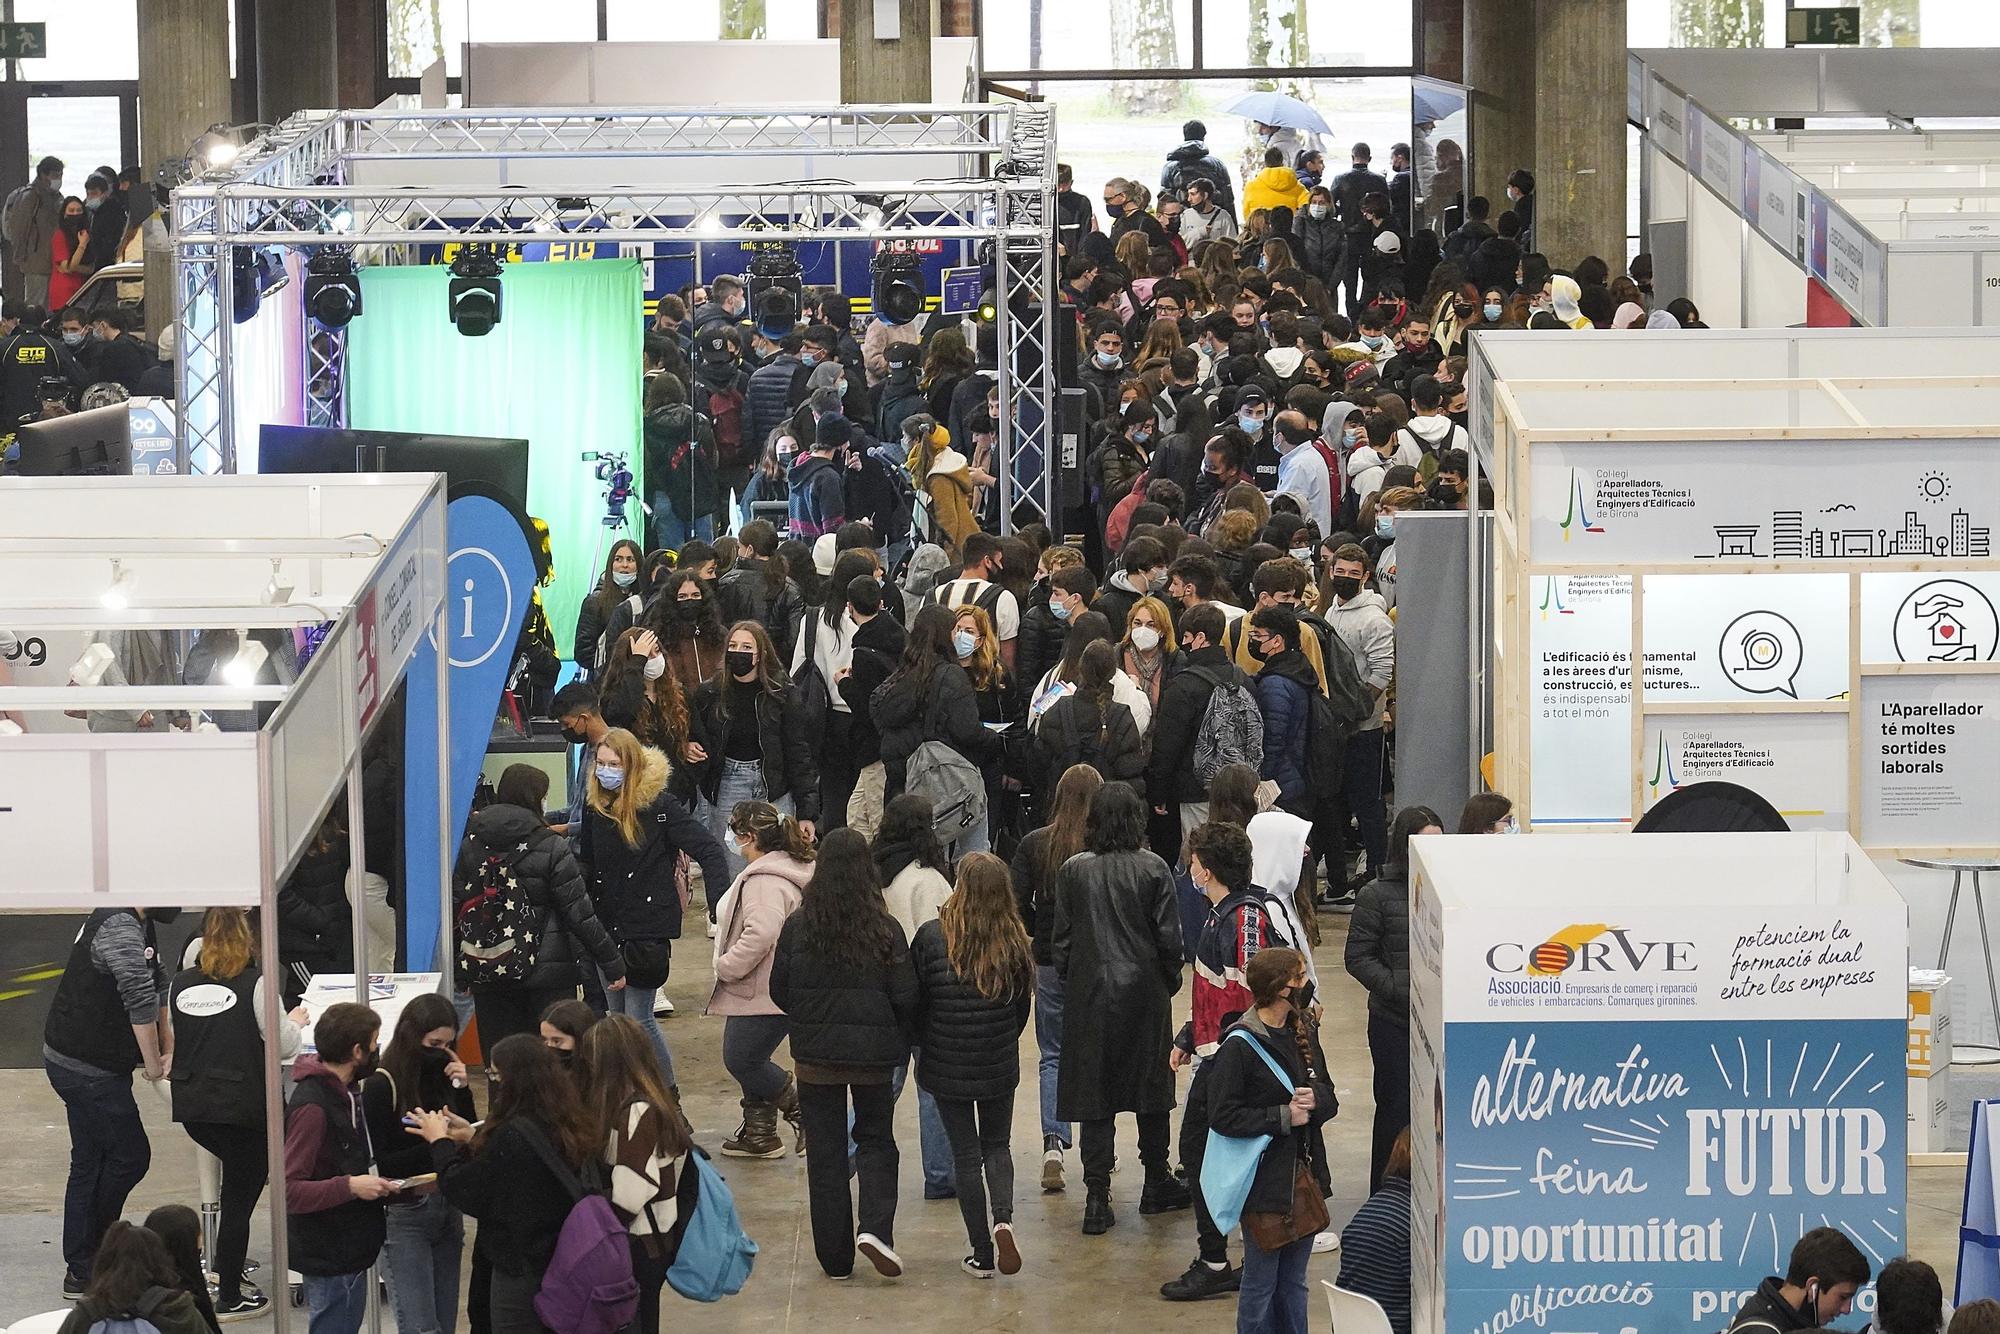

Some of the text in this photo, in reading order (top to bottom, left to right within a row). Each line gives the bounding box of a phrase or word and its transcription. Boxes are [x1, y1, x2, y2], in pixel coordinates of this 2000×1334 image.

[1596, 480, 1664, 489] d'Aparelladors,
[1596, 490, 1650, 499] Arquitectes
[1652, 489, 1687, 498] Tècnics
[1596, 499, 1696, 509] Enginyers d'Edificació
[1596, 509, 1639, 518] de Girona
[1568, 588, 1603, 596] Enginyers
[1543, 651, 1610, 662] L'edificació
[1612, 652, 1626, 661] és
[1543, 668, 1550, 676] a
[1552, 666, 1570, 676] les
[1573, 666, 1606, 676] àrees
[1543, 680, 1617, 691] construcció,
[1543, 694, 1631, 706] és indispensabl
[1543, 707, 1609, 718] a tot el món
[1881, 702, 1984, 719] L'Aparellador
[1881, 722, 1956, 735] té moltes
[1682, 741, 1745, 749] d'Aparelladors,
[1881, 741, 1947, 755] sortides
[1682, 750, 1732, 759] Arquitectes
[1734, 749, 1766, 758] Tècnics
[1682, 758, 1775, 768] Enginyers d'Edificació
[1881, 760, 1944, 774] laborals
[1732, 919, 1853, 957] potenciem la
[1485, 929, 1699, 974] CORVE
[1730, 942, 1863, 981] formació dual
[1565, 984, 1610, 995] Empresaris
[1612, 983, 1622, 993] de
[1623, 983, 1654, 996] comerç
[1660, 983, 1698, 995] reparació
[1720, 970, 1876, 1000] entre les empreses
[1488, 998, 1499, 1007] de
[1500, 997, 1535, 1006] vehicles
[1544, 996, 1606, 1006] embarcacions.
[1607, 995, 1655, 1007] Comarques
[1656, 994, 1698, 1007] gironines.
[1470, 1034, 1690, 1128] alternativa
[1685, 1107, 1888, 1196] FUTUR
[1530, 1147, 1648, 1195] feina
[1462, 1217, 1724, 1269] oportunitat
[1468, 1280, 1654, 1334] alificació
